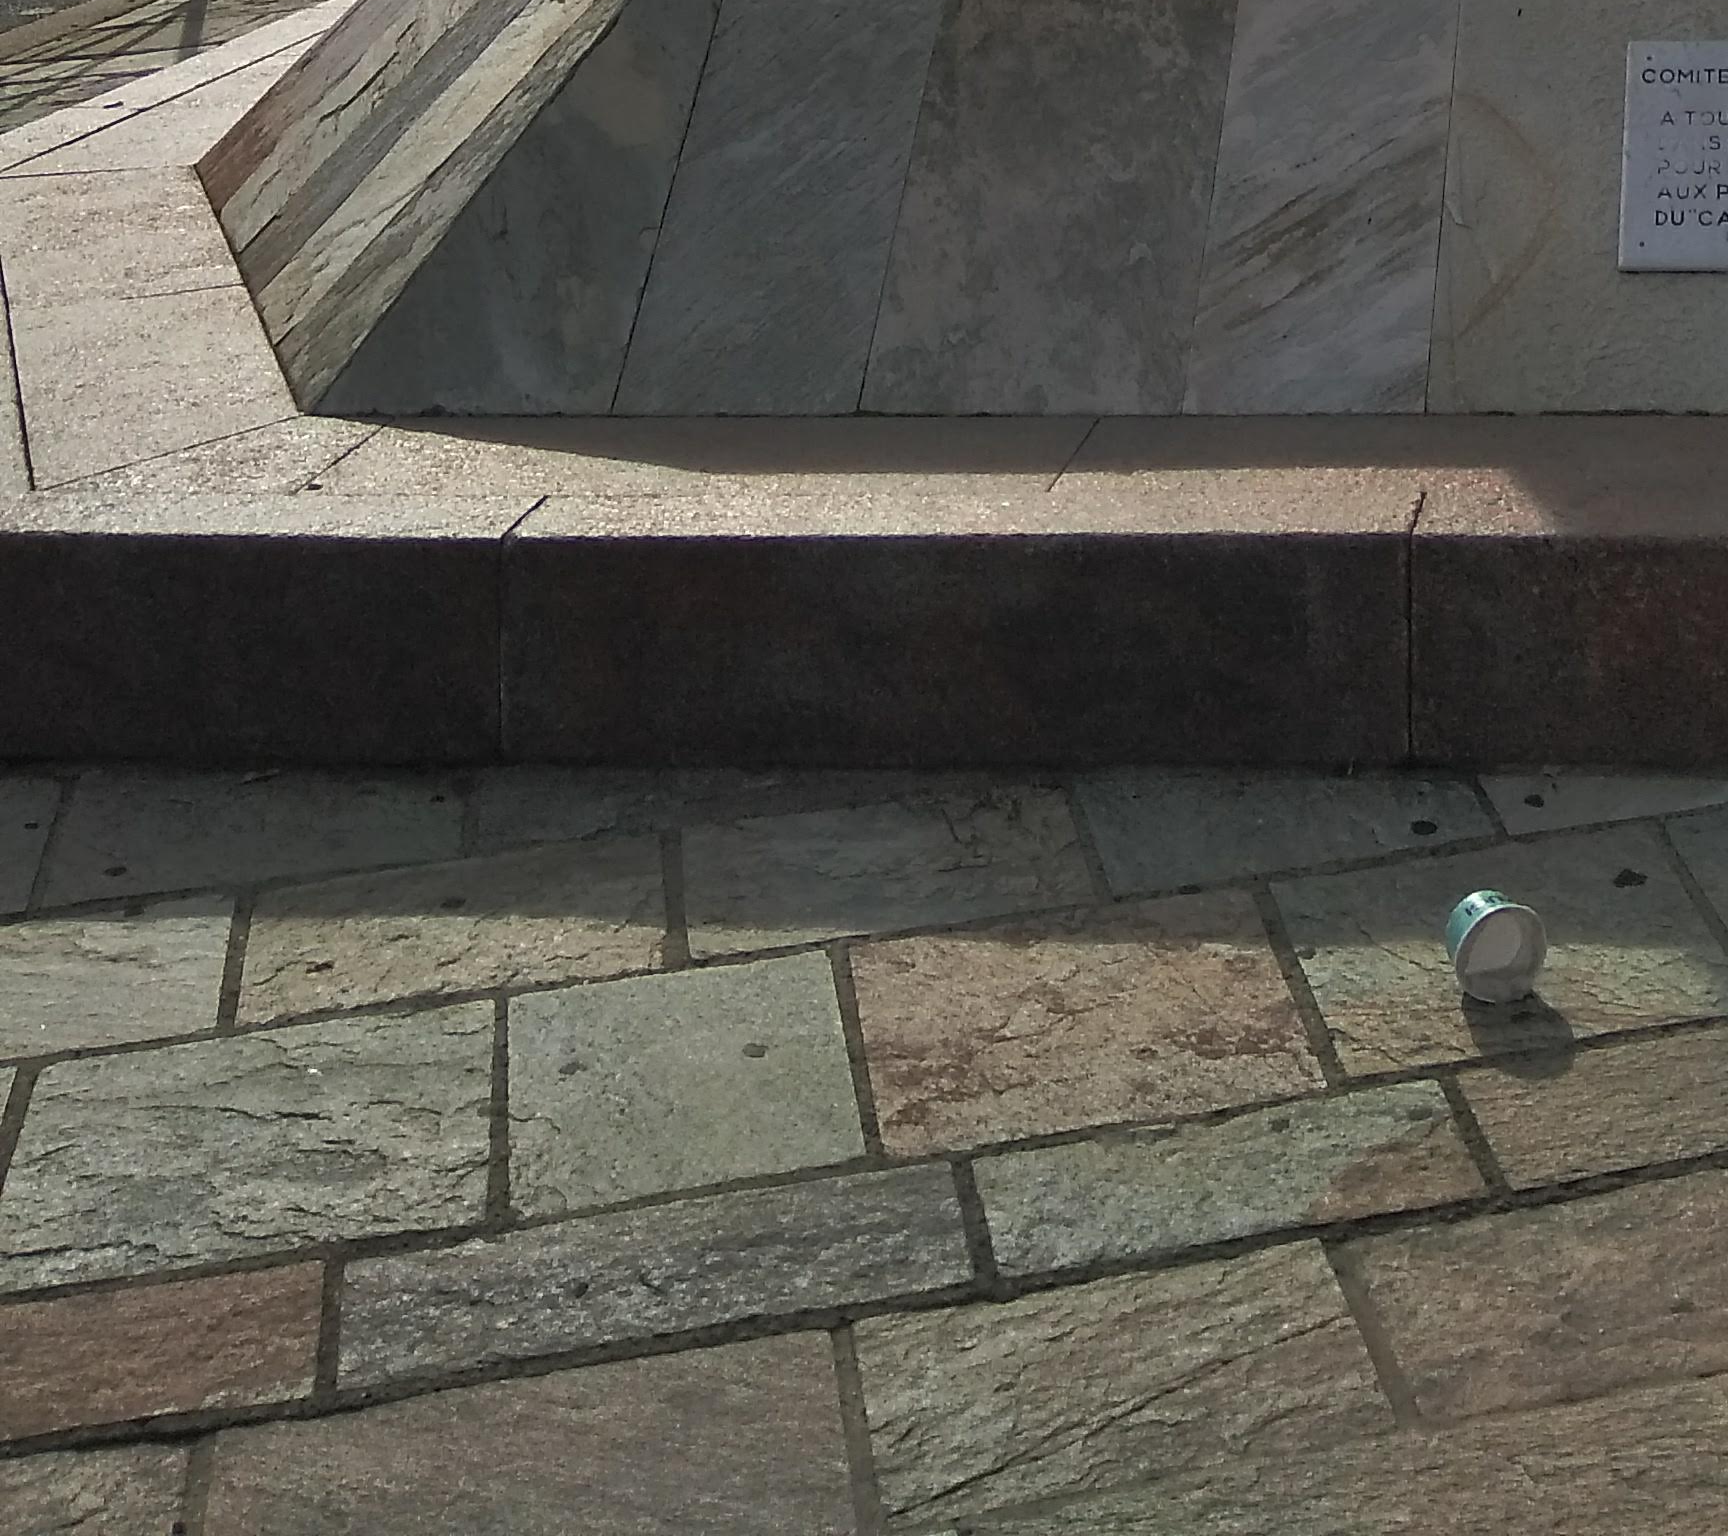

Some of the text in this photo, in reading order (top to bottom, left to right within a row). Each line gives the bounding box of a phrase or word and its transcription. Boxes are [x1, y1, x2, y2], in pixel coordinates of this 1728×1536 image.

[1660, 110, 1675, 126] A
[1657, 184, 1707, 200] AUX
[1655, 209, 1685, 226] DU
